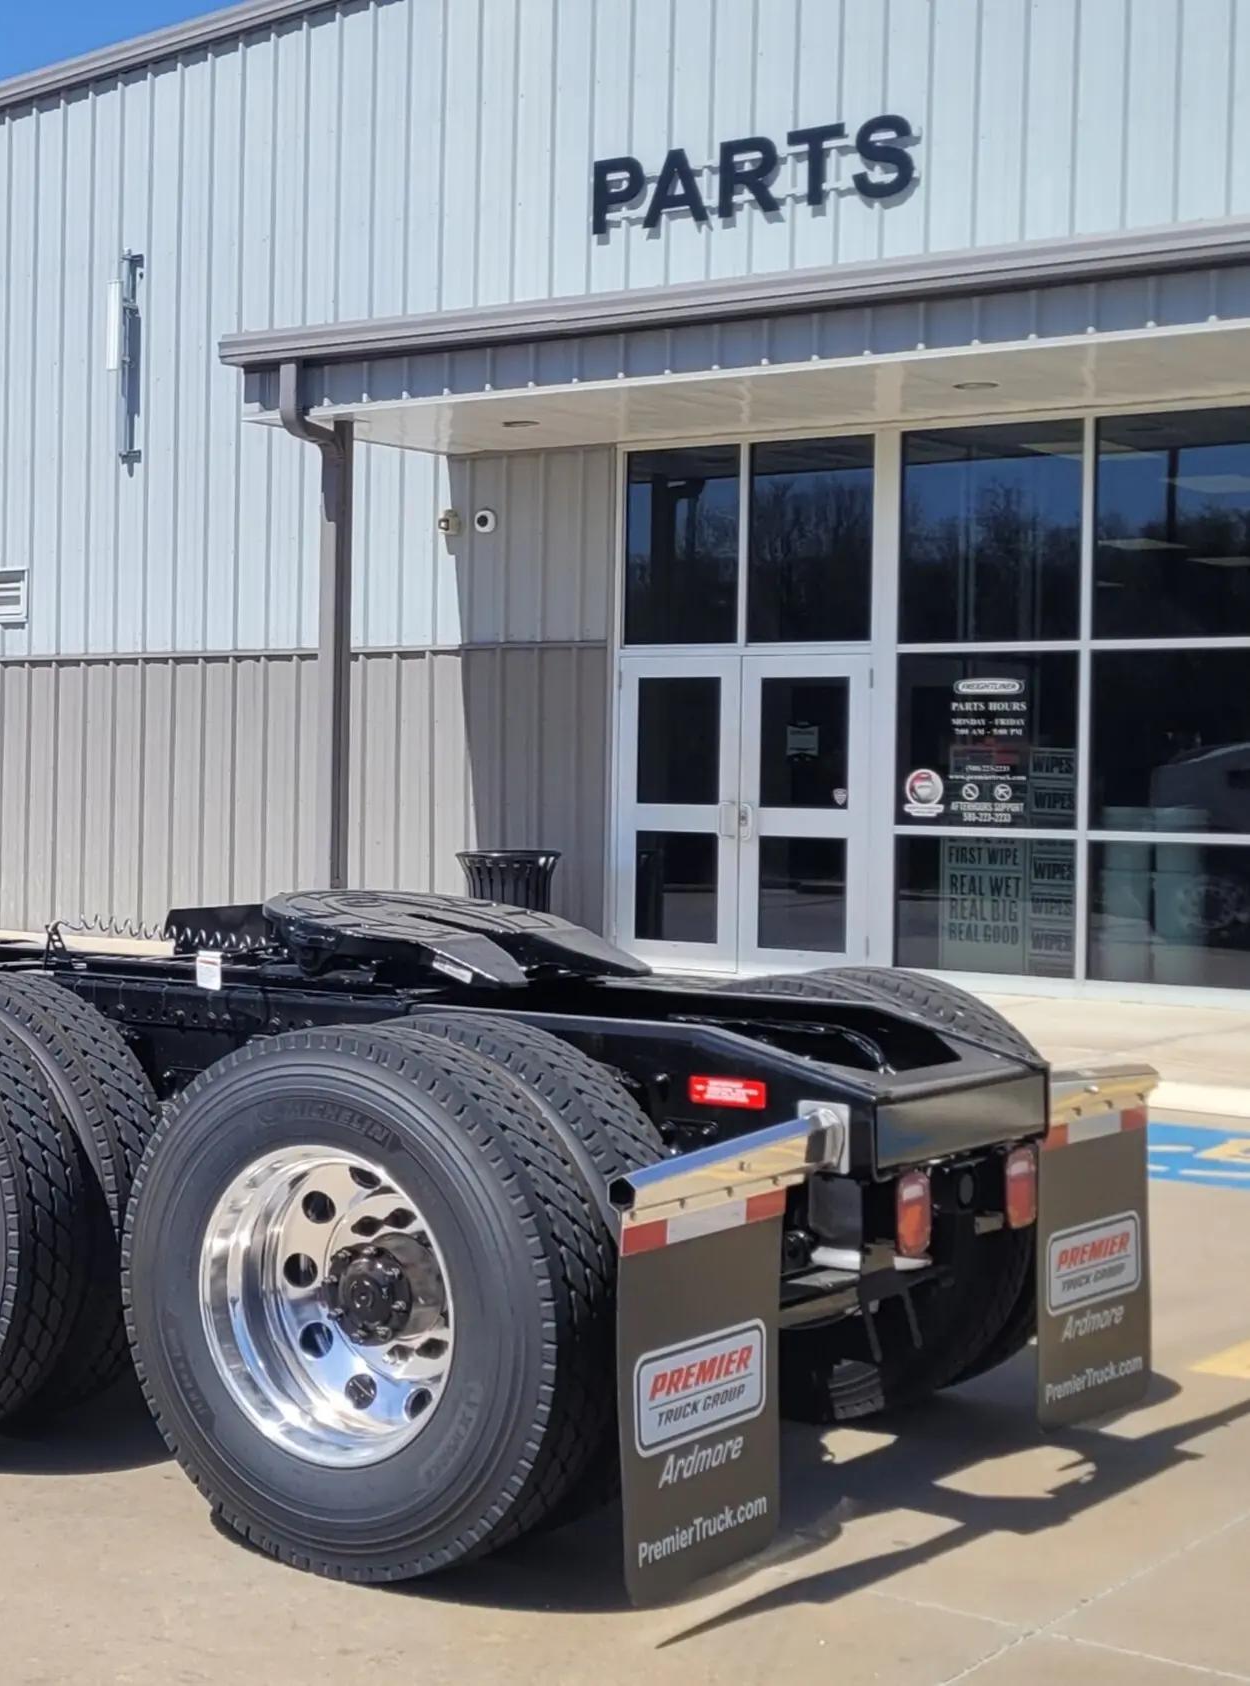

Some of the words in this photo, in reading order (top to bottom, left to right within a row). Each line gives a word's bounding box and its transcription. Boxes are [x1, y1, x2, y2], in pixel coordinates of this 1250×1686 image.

[592, 114, 916, 235] PARTS
[951, 702, 986, 711] PARTS
[988, 702, 1027, 711] HOURS
[951, 718, 986, 726] MONDAY
[994, 718, 1025, 726] FRIDAY
[948, 845, 982, 865] FIRST
[988, 847, 1019, 866] WIPE
[949, 874, 985, 896] REAL
[989, 876, 1021, 898] WET
[949, 898, 987, 921] REAL
[948, 922, 980, 942] REAL
[983, 924, 1019, 945] GOOD
[1057, 1231, 1131, 1273] PREMIER
[1060, 1305, 1124, 1343] Ardmore
[648, 1344, 754, 1402] PREMIER
[1045, 1356, 1143, 1405] PremierTruck.com
[657, 1399, 700, 1428] TRUCK
[702, 1383, 746, 1411] GROUP
[657, 1435, 744, 1489] Ardmore
[637, 1495, 768, 1568] PremierTruck.com
